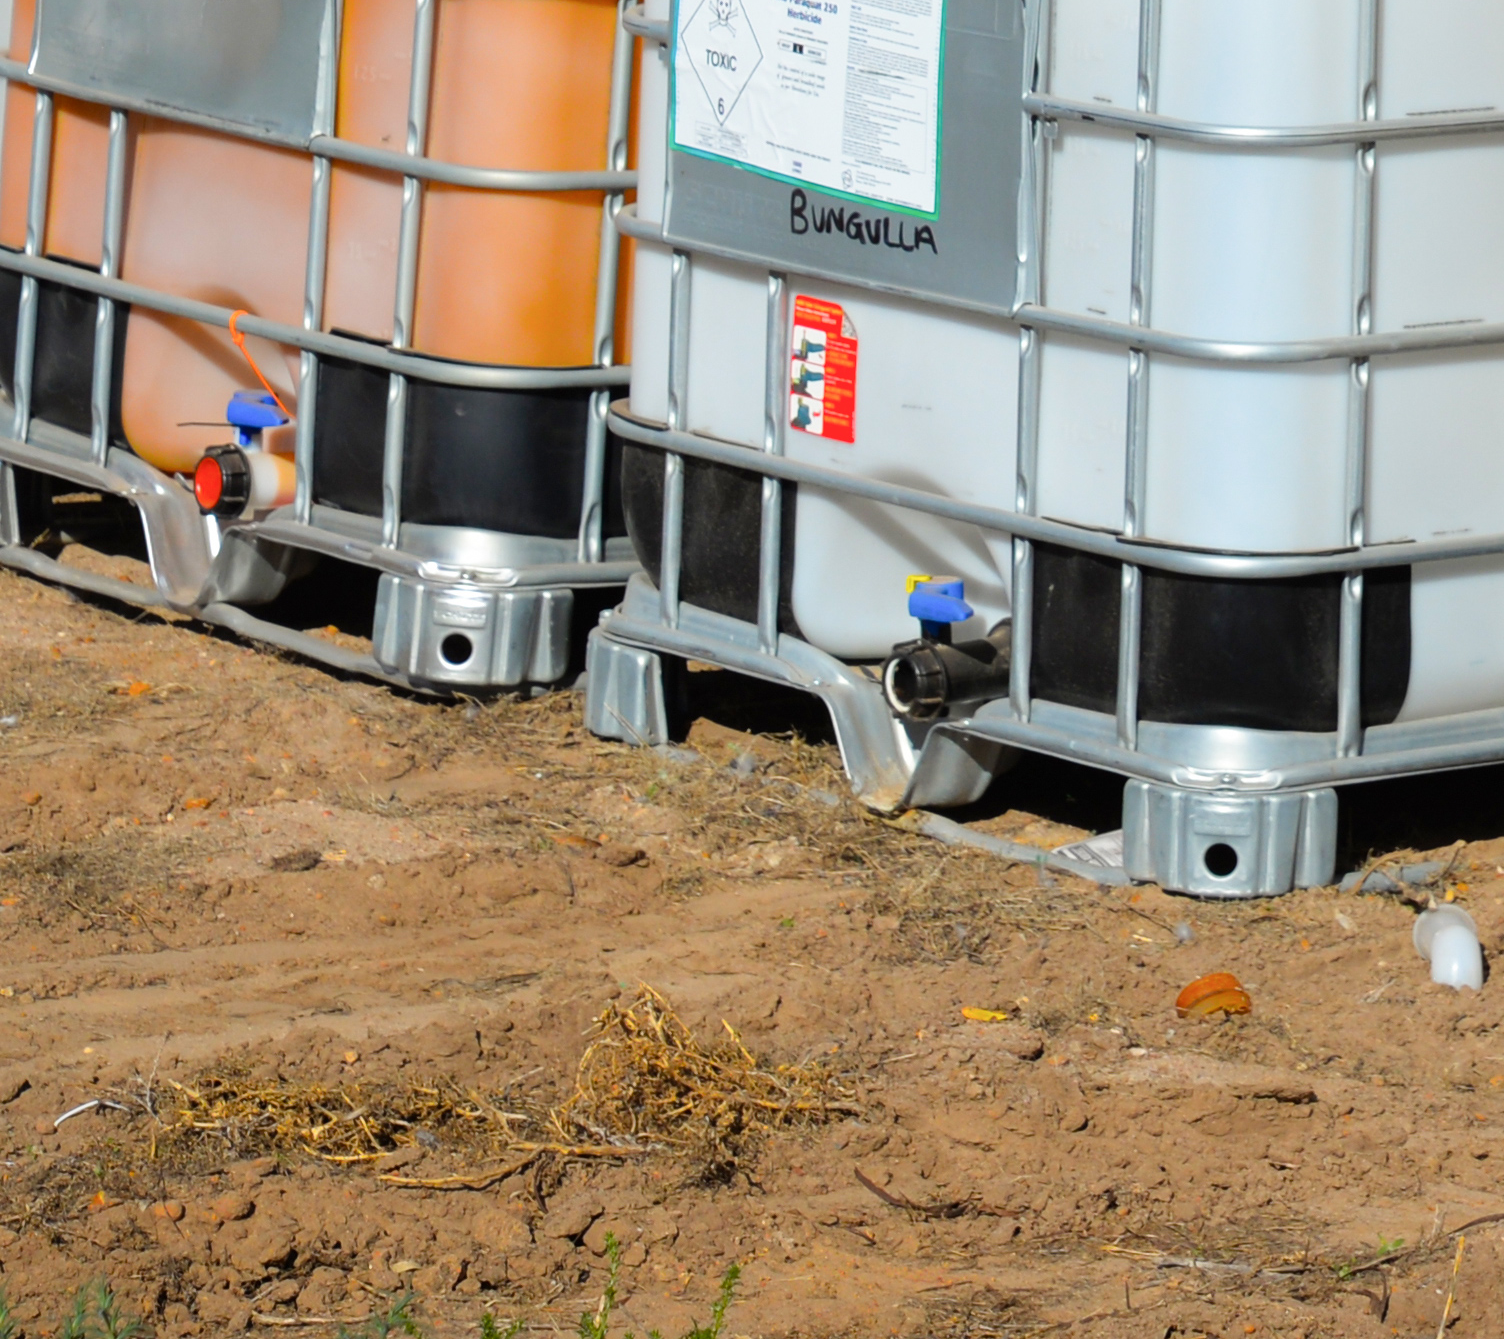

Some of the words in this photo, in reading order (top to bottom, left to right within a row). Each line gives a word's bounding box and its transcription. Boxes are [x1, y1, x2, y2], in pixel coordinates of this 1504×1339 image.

[787, 8, 823, 25] Herbicide
[824, 2, 838, 14] 250
[706, 49, 737, 72] TOXIC
[718, 97, 725, 115] 6
[791, 188, 938, 255] BUNGULLA
